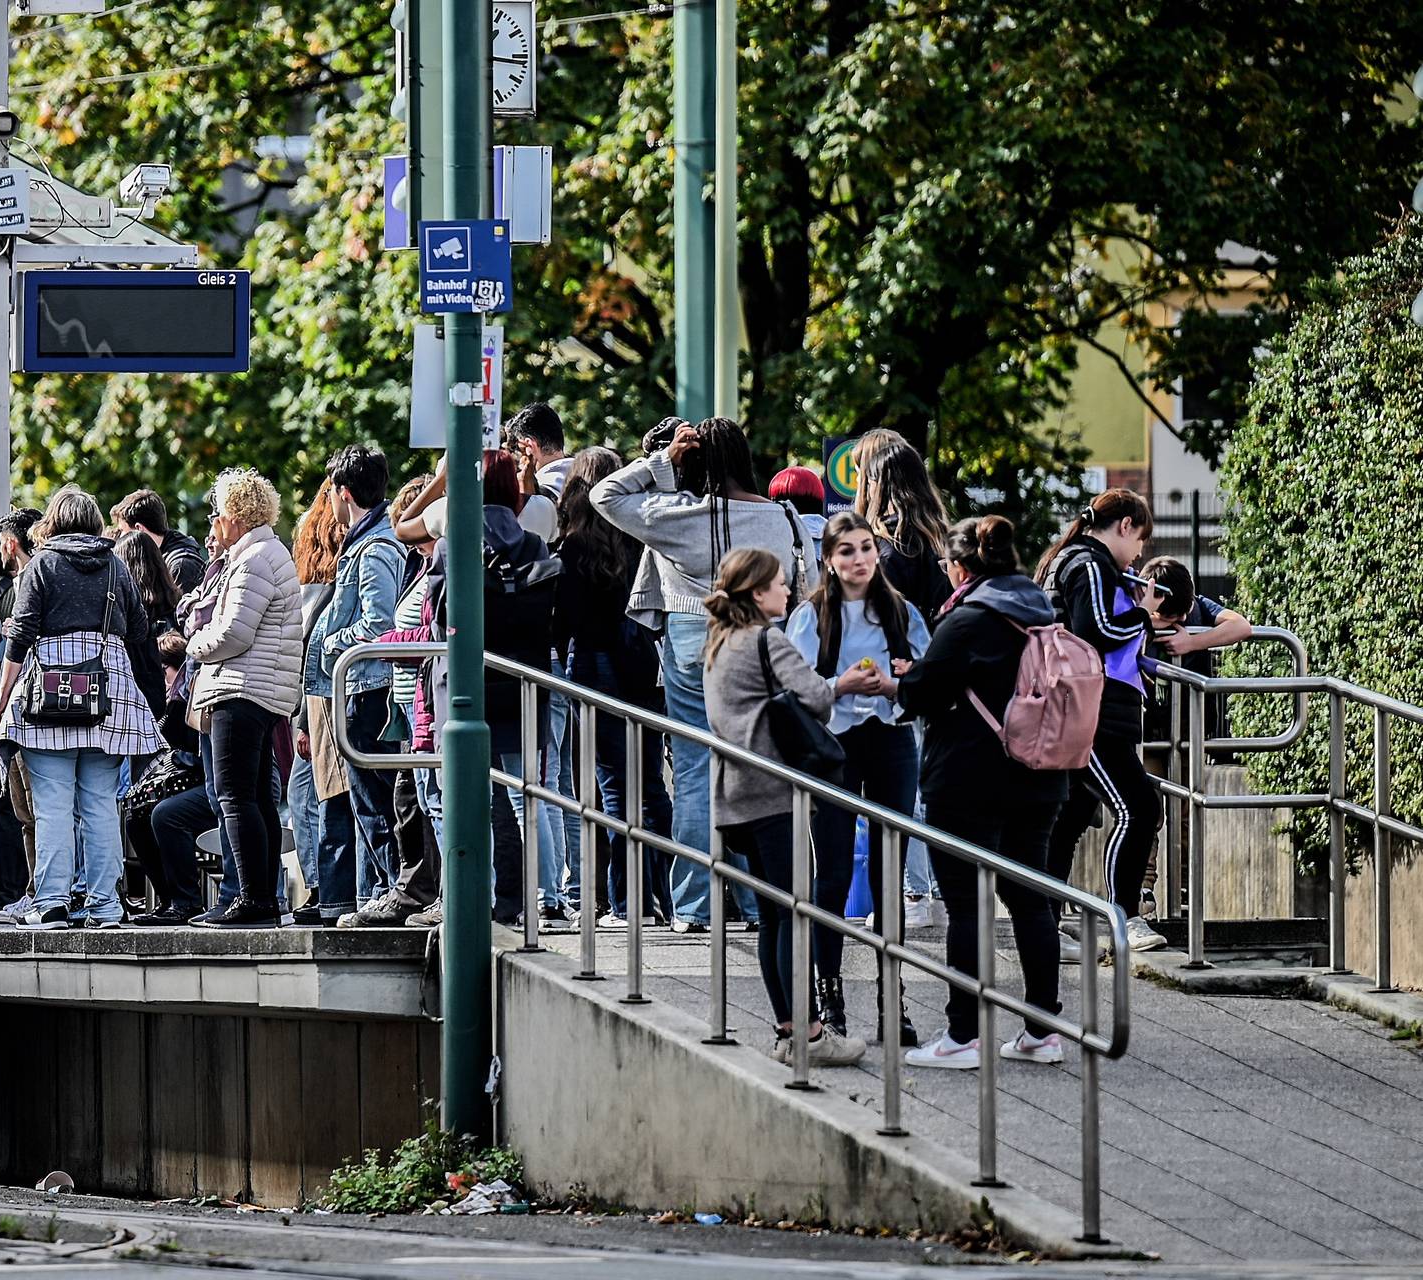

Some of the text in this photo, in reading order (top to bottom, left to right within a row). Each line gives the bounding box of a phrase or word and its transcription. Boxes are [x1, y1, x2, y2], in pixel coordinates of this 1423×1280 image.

[198, 272, 237, 285] Gleis 2
[426, 278, 468, 291] Bahnhof
[426, 293, 444, 304] mit
[445, 292, 473, 304] Video
